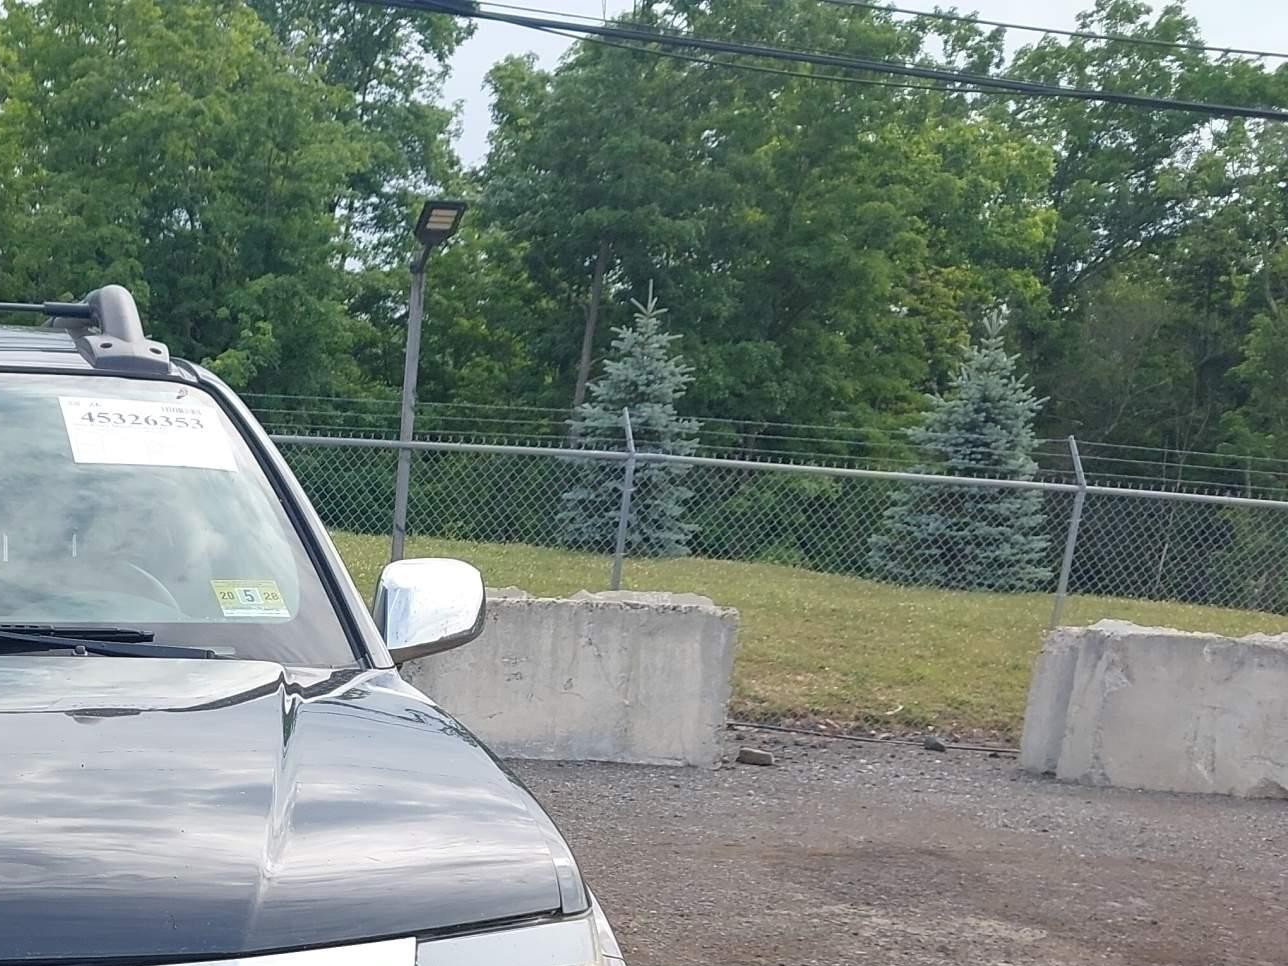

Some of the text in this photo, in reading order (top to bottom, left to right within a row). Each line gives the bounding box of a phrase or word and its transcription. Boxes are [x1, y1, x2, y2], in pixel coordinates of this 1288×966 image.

[80, 411, 205, 430] 45326353
[219, 591, 235, 600] 20
[243, 589, 256, 602] 5
